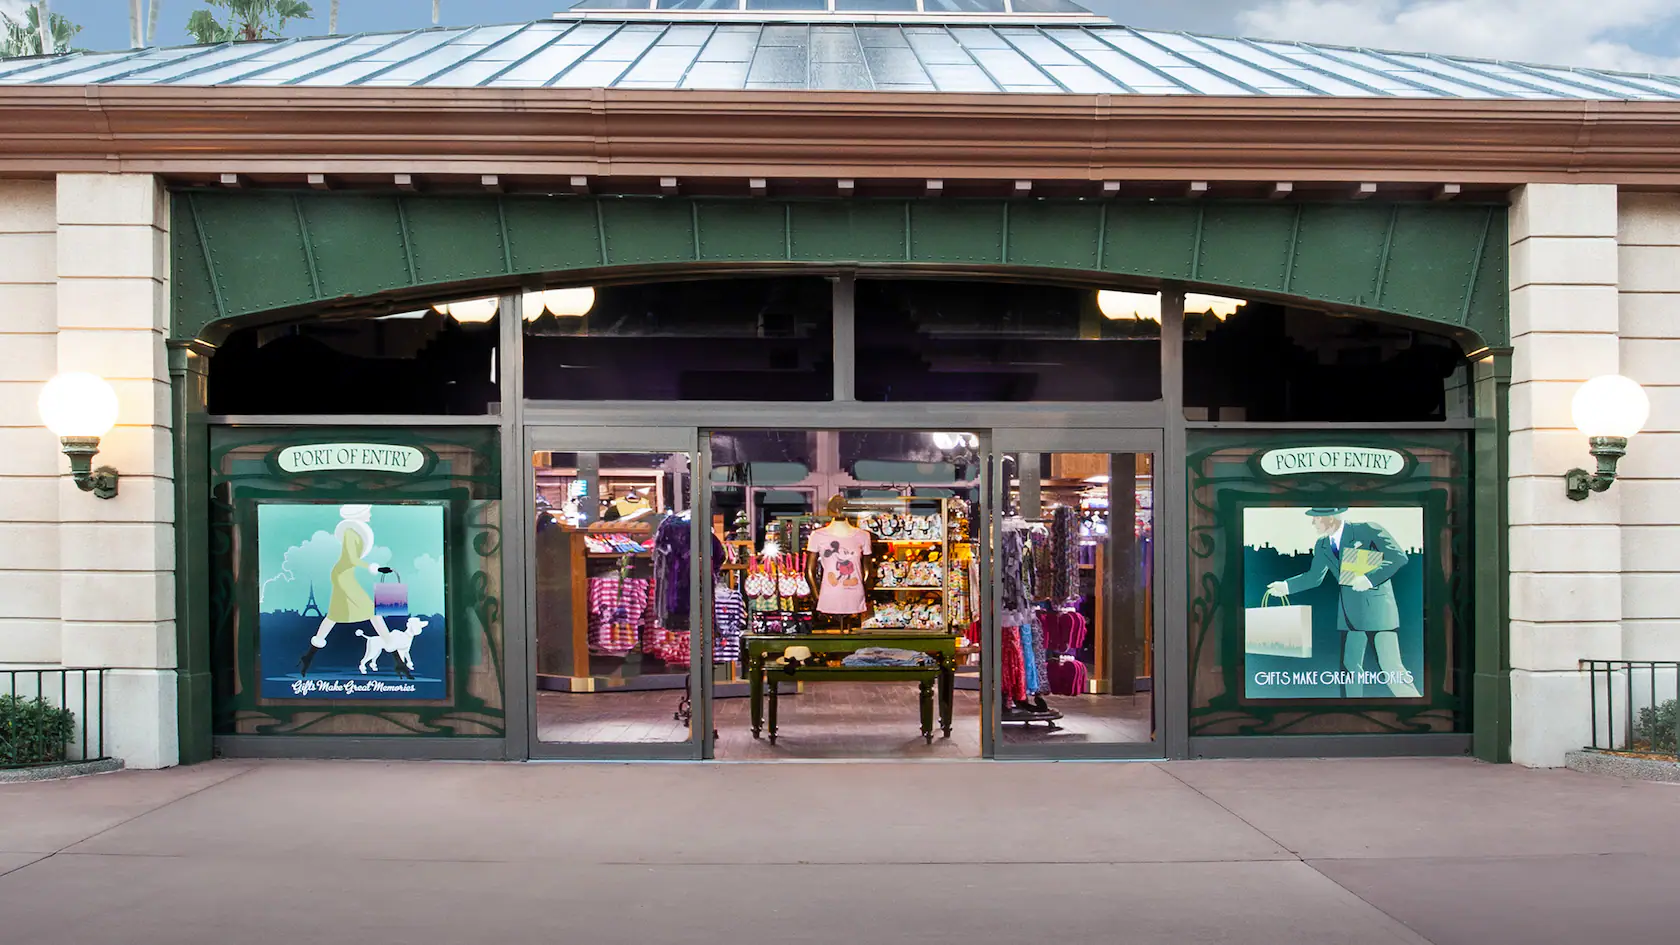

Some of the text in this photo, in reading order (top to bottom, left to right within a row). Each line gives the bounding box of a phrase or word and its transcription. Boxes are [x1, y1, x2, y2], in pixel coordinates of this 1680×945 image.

[293, 448, 412, 467] PORT OF ENTRY
[1275, 451, 1393, 470] PORT OF ENTRY
[1254, 670, 1414, 686] GIFTS MAKE GREAT MEMORIES
[291, 679, 416, 696] Gifts Make Great Memories
